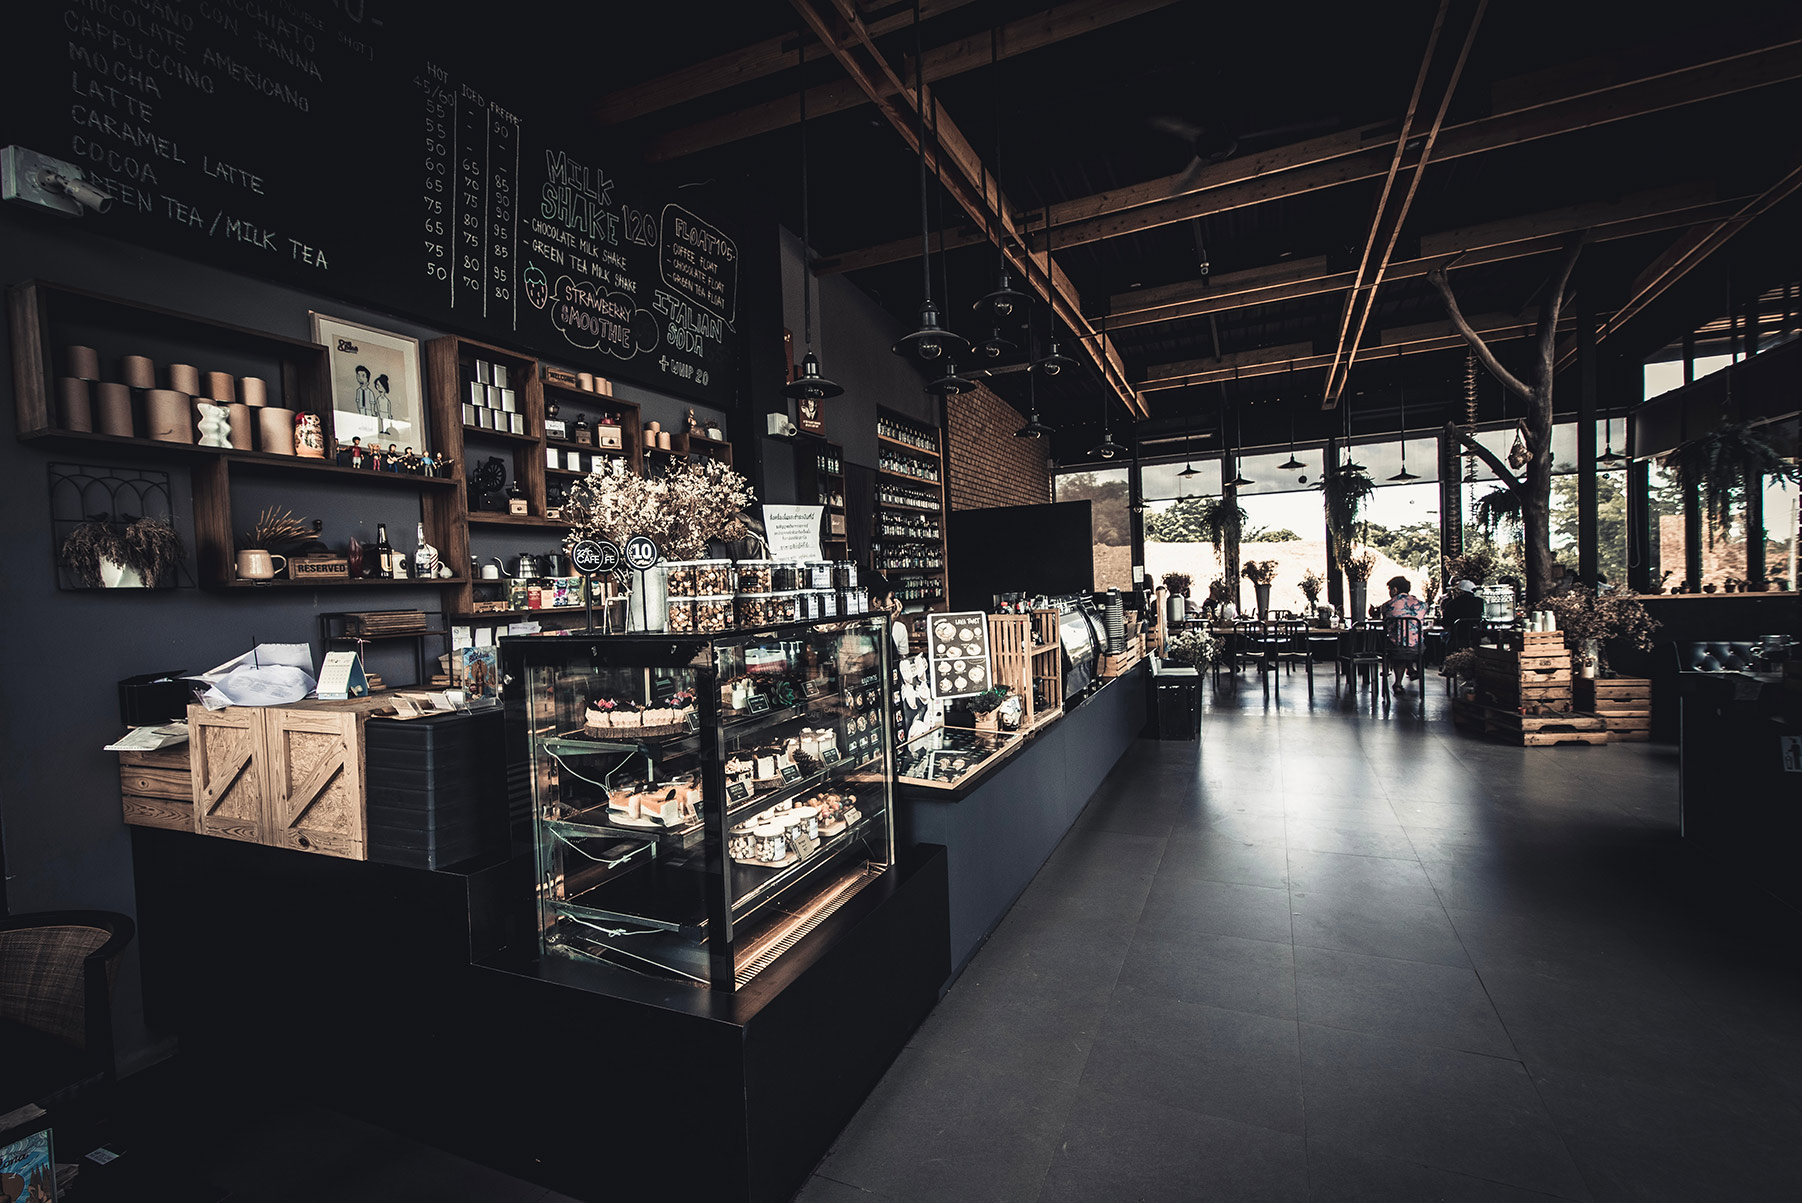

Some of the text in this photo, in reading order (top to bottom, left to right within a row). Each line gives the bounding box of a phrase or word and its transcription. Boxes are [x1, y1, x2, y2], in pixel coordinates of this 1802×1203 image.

[64, 10, 214, 94] CAPPUCCINO
[68, 41, 162, 99] MOCHA
[72, 71, 152, 123] LATTE
[203, 48, 309, 112] AMERICANO
[426, 61, 449, 84] HOT
[461, 83, 485, 107] ICED
[426, 99, 445, 118] 55
[426, 118, 446, 138] 55
[72, 104, 264, 196] CARAMEL LATTE
[72, 135, 158, 184] COCOA
[426, 138, 509, 192] 50 65 85
[425, 157, 510, 207] 60 70 90
[425, 177, 510, 221] 65 75 90
[545, 149, 615, 206] MILK
[423, 196, 508, 239] 75 80 95
[541, 182, 658, 247] SHAKE 120
[674, 217, 716, 255] FLOAT
[288, 238, 328, 269] TEA
[425, 218, 508, 258] 65 75 85
[531, 217, 627, 272] CHOCOLATE MILK SHAKE
[672, 242, 719, 275] COFFEE FLOAT
[424, 241, 507, 281] 75 80 95
[426, 262, 510, 300] 50 70 80
[532, 239, 637, 294] GREEN TEA MILK SHAKE
[672, 258, 725, 294] CHOCOLATE FLOAT
[565, 284, 632, 323] STRAWBERRY
[672, 272, 726, 310] GREEN TEA FLOAT
[560, 304, 631, 349] SMOOTHIE
[652, 289, 723, 344] ITALIAN
[666, 322, 704, 358] SODA
[694, 368, 709, 386] 20
[297, 564, 346, 573] RESERVED
[576, 555, 600, 564] CAFE
[632, 543, 652, 561] 10
